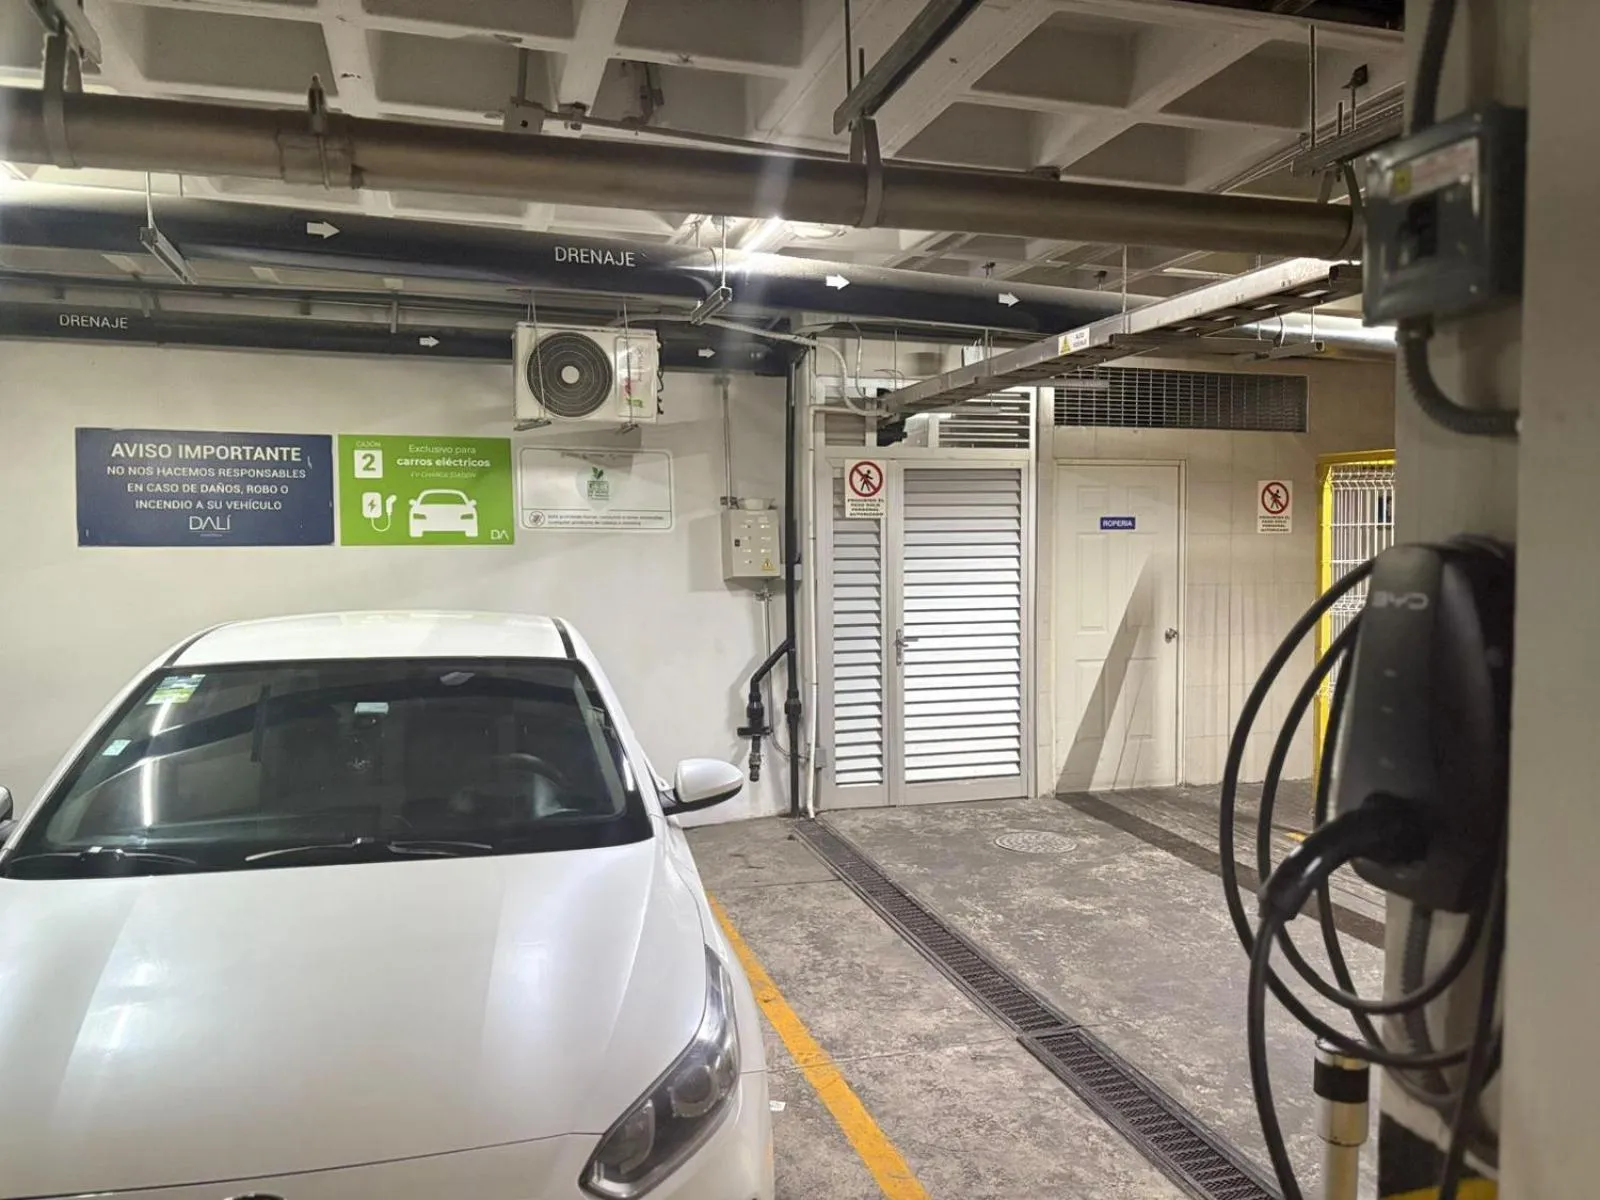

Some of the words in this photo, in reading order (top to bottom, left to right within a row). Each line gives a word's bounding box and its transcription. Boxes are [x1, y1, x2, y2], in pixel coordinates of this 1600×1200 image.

[554, 246, 637, 267] DRENAJE
[59, 314, 129, 329] DRENAJE
[111, 443, 172, 459] AVISO
[178, 444, 302, 461] IMPORTANTE
[409, 444, 453, 454] Exclusivo
[456, 446, 476, 456] para
[362, 453, 376, 471] 2
[397, 458, 433, 467] carros
[435, 457, 491, 467] eléctricos
[107, 466, 125, 476] NO
[128, 466, 154, 477] NOS
[157, 466, 215, 477] HACEMOS
[218, 468, 306, 479] RESPONSABLES
[127, 483, 144, 493] EN
[146, 483, 179, 493] CASO
[182, 484, 198, 493] DE
[200, 482, 244, 495] DAÑOS,
[246, 485, 277, 495] ROBO
[280, 486, 289, 495] O
[135, 500, 192, 510] INCENDIO
[195, 501, 205, 510] A
[207, 501, 223, 510] SU
[225, 499, 282, 510] VEHÍCULO
